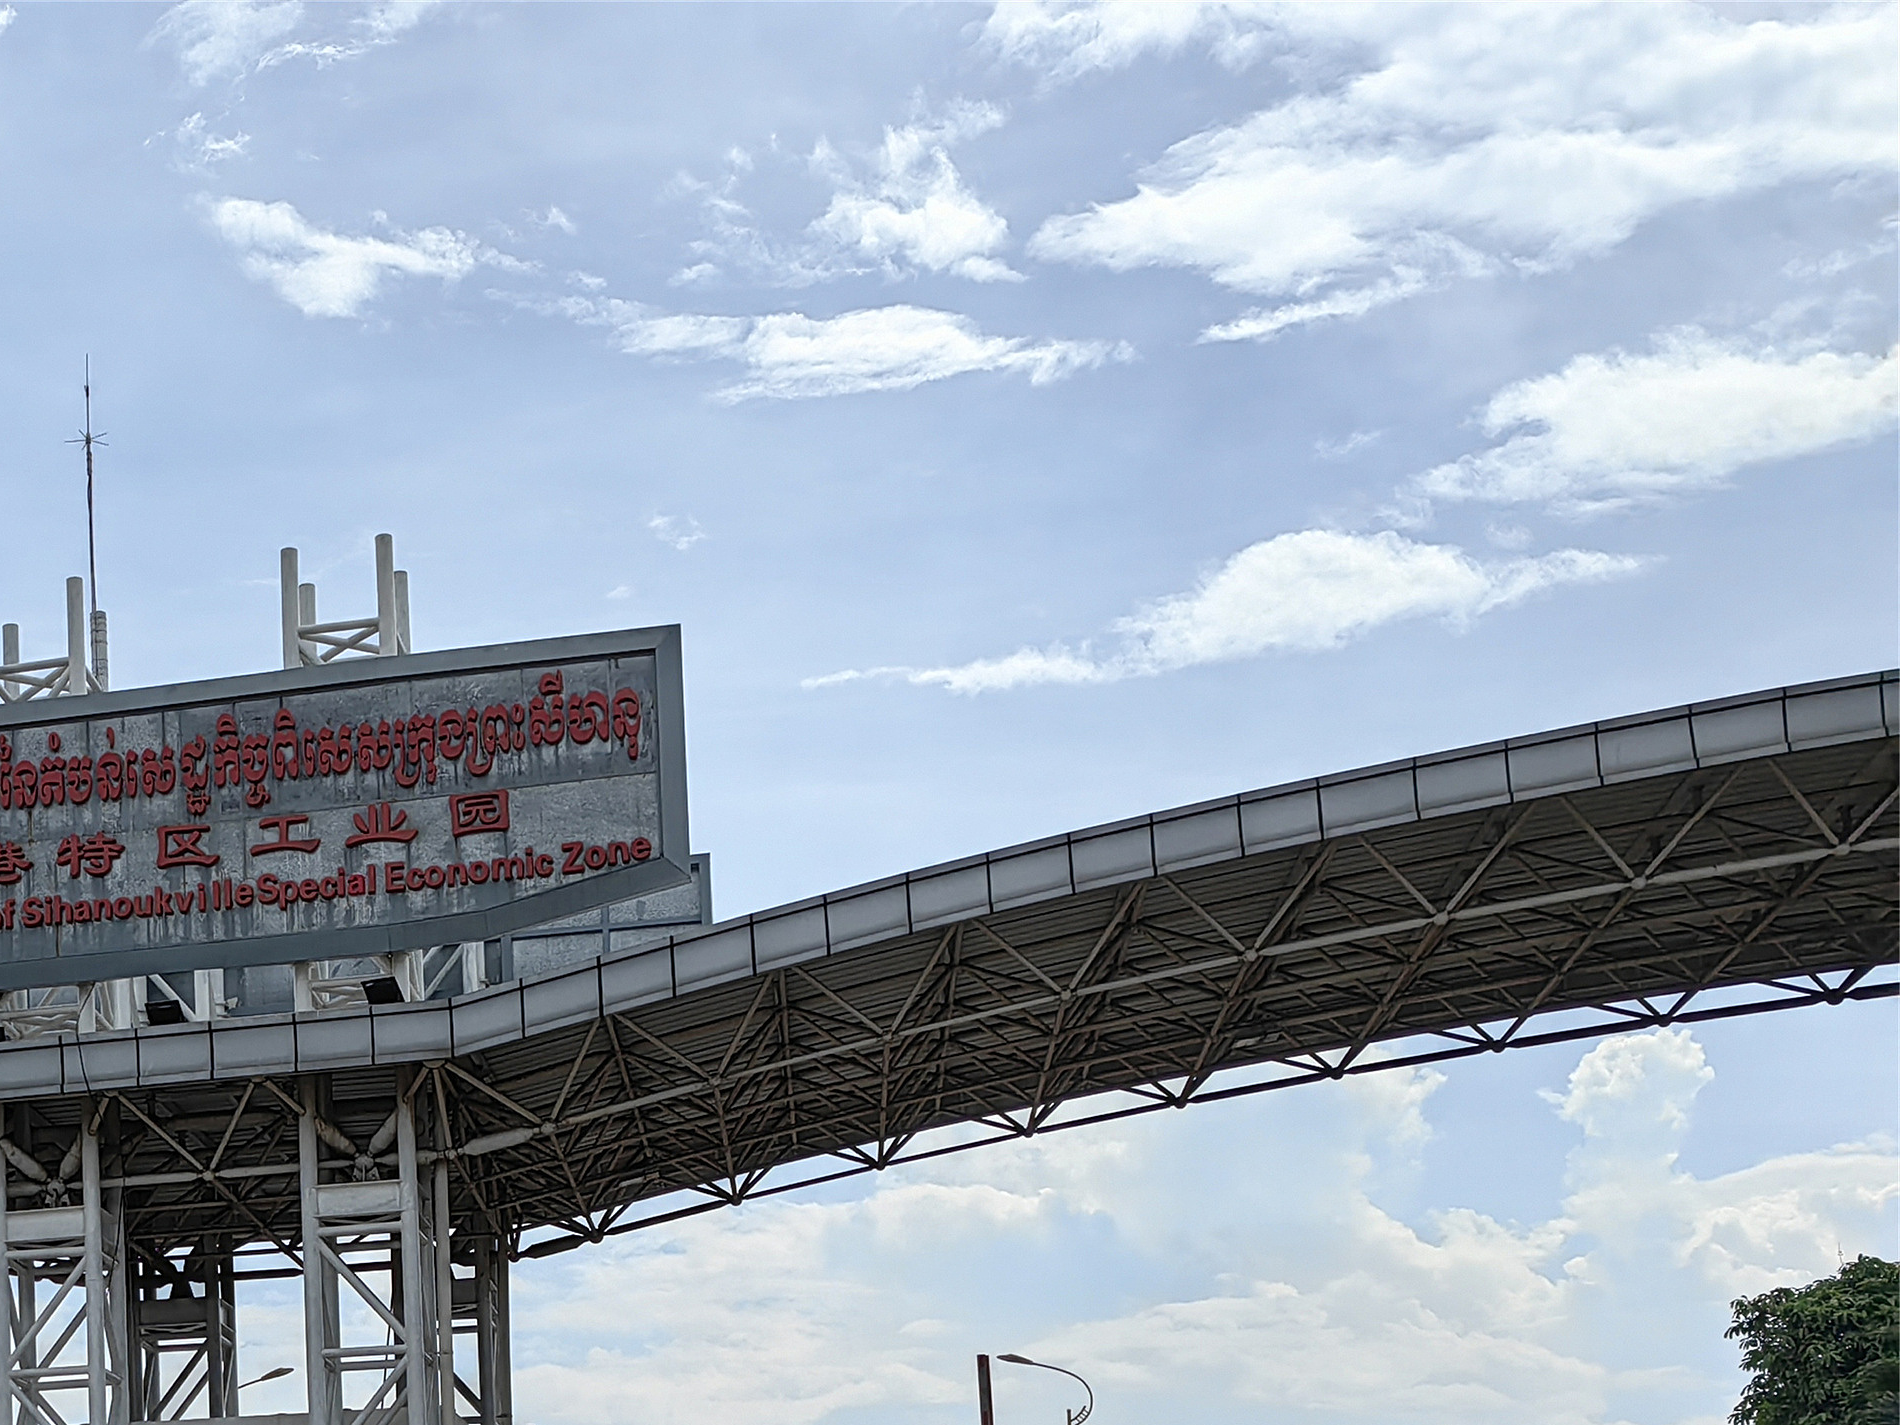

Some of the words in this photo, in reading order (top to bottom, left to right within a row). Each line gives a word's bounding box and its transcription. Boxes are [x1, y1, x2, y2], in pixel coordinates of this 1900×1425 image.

[20, 880, 253, 927] Sihanoukville
[256, 863, 377, 911] Special
[385, 846, 554, 893] Economic
[561, 836, 652, 875] Zone
